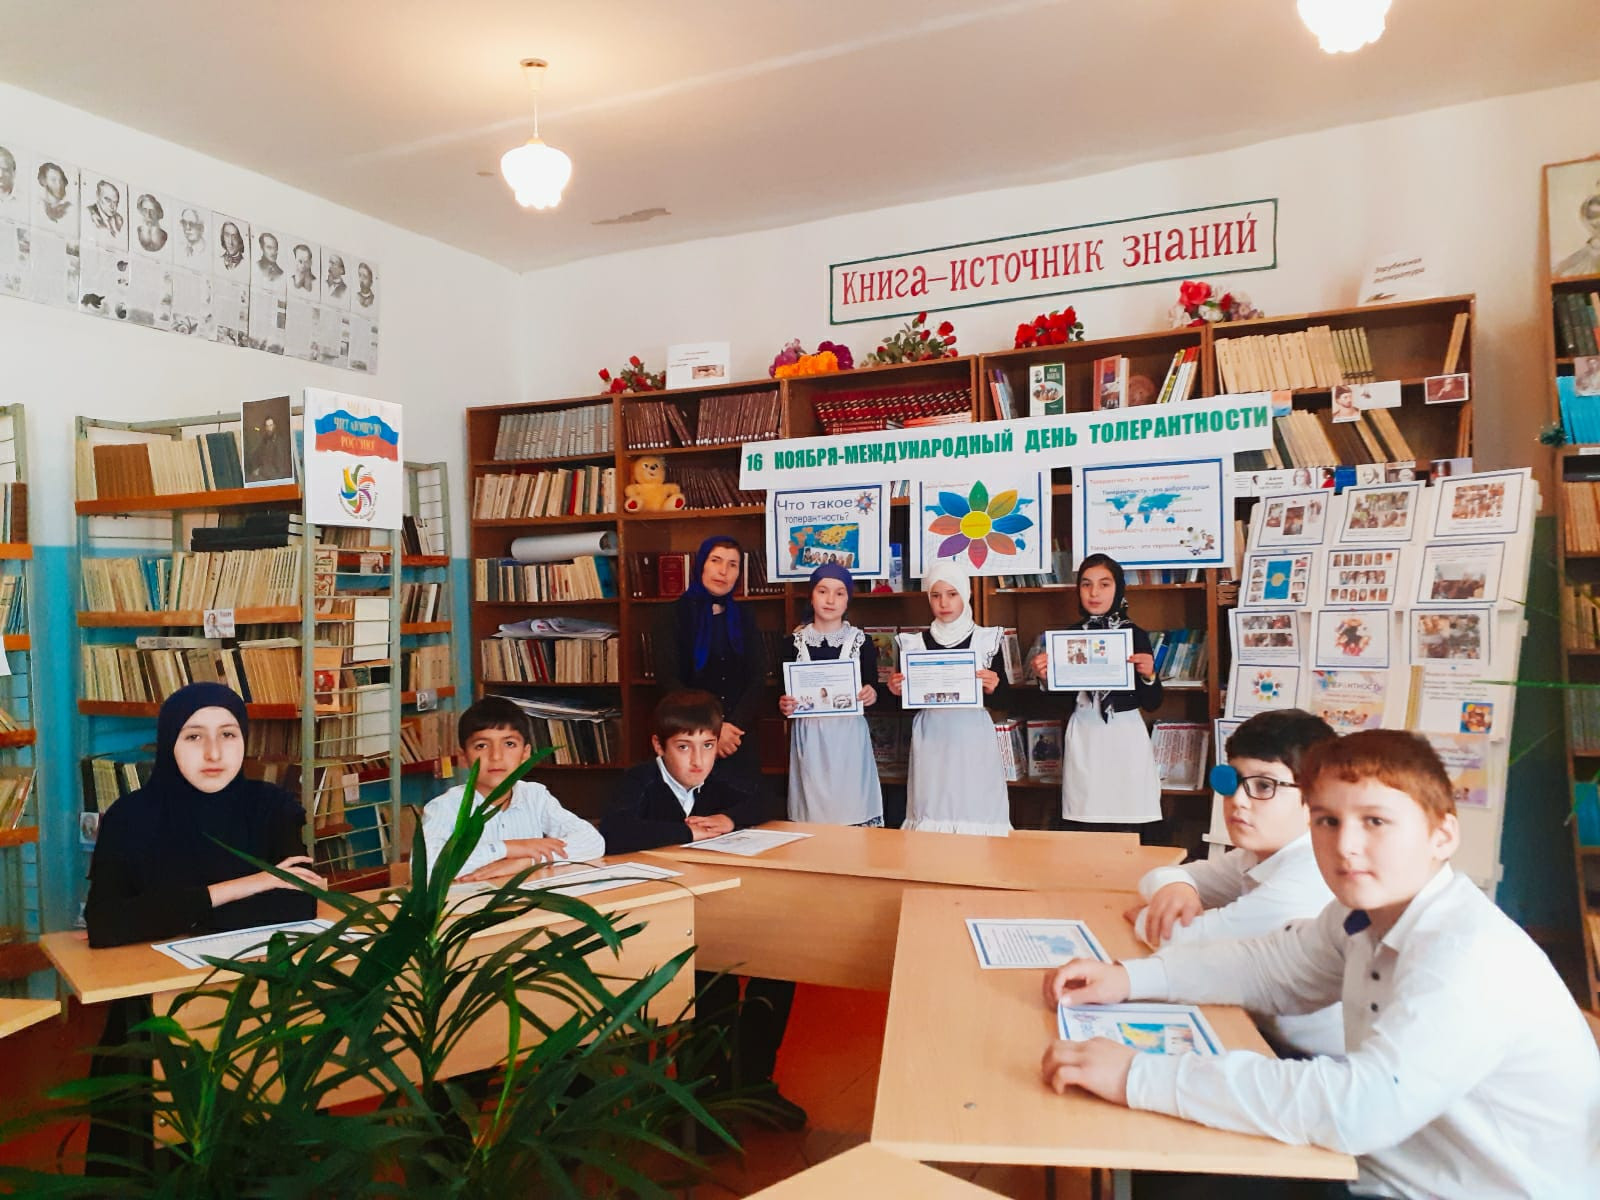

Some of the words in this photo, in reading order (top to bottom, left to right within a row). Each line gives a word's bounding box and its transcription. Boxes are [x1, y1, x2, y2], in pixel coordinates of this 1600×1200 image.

[1122, 212, 1258, 268] знаний
[745, 453, 763, 471] 16
[1025, 427, 1077, 454] ДЕНЬ
[1089, 405, 1268, 445] ТОЛЕРАНТНОСТИ
[777, 500, 805, 511] Что
[810, 499, 853, 510] такое
